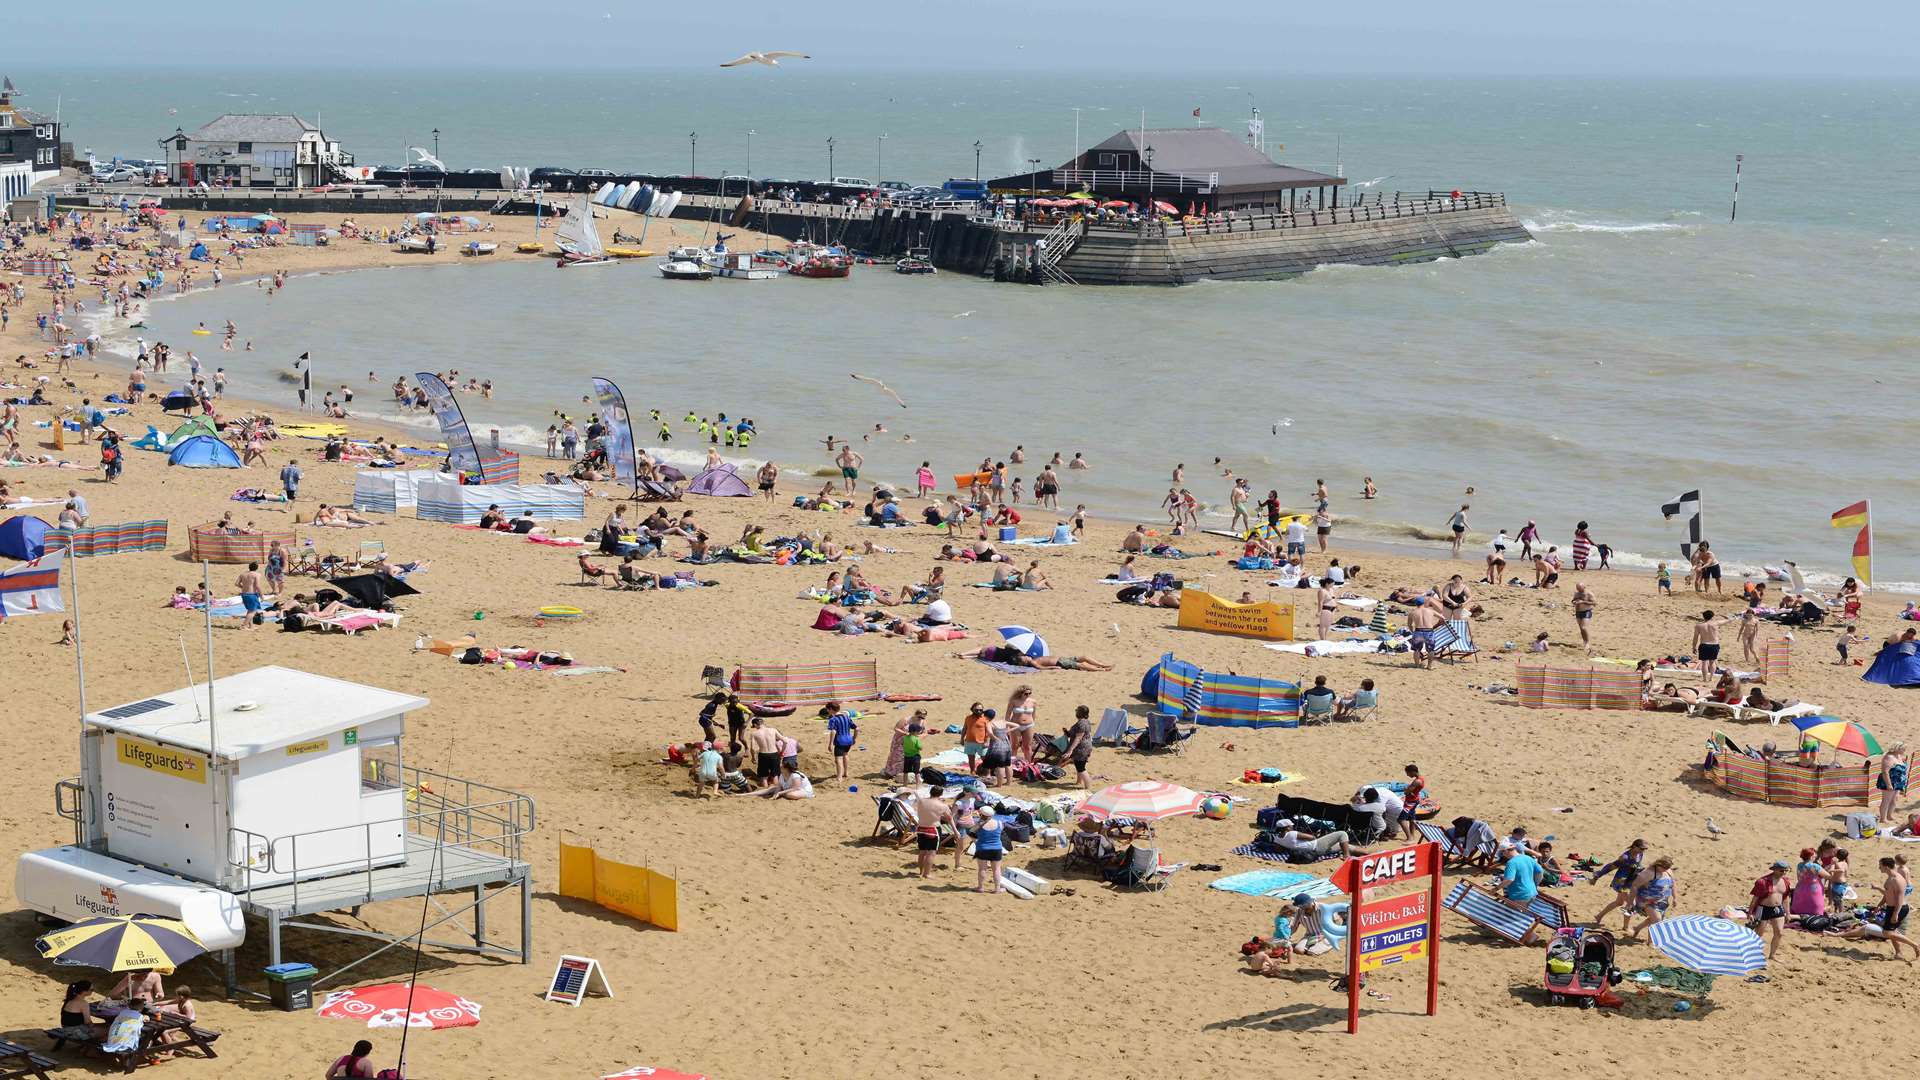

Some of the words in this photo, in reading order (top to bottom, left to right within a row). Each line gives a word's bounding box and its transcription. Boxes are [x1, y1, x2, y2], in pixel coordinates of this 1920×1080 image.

[1211, 602, 1237, 613] Always
[1205, 610, 1237, 620] between
[1239, 614, 1252, 622] the
[1219, 620, 1244, 630] yellow
[1246, 624, 1268, 632] flags
[124, 744, 184, 771] Lifeguards
[1362, 850, 1416, 883] CAFE
[75, 894, 120, 916] Lifeguards
[1382, 928, 1422, 946] TOILETS
[136, 950, 145, 958] B
[126, 958, 159, 966] BULMERS
